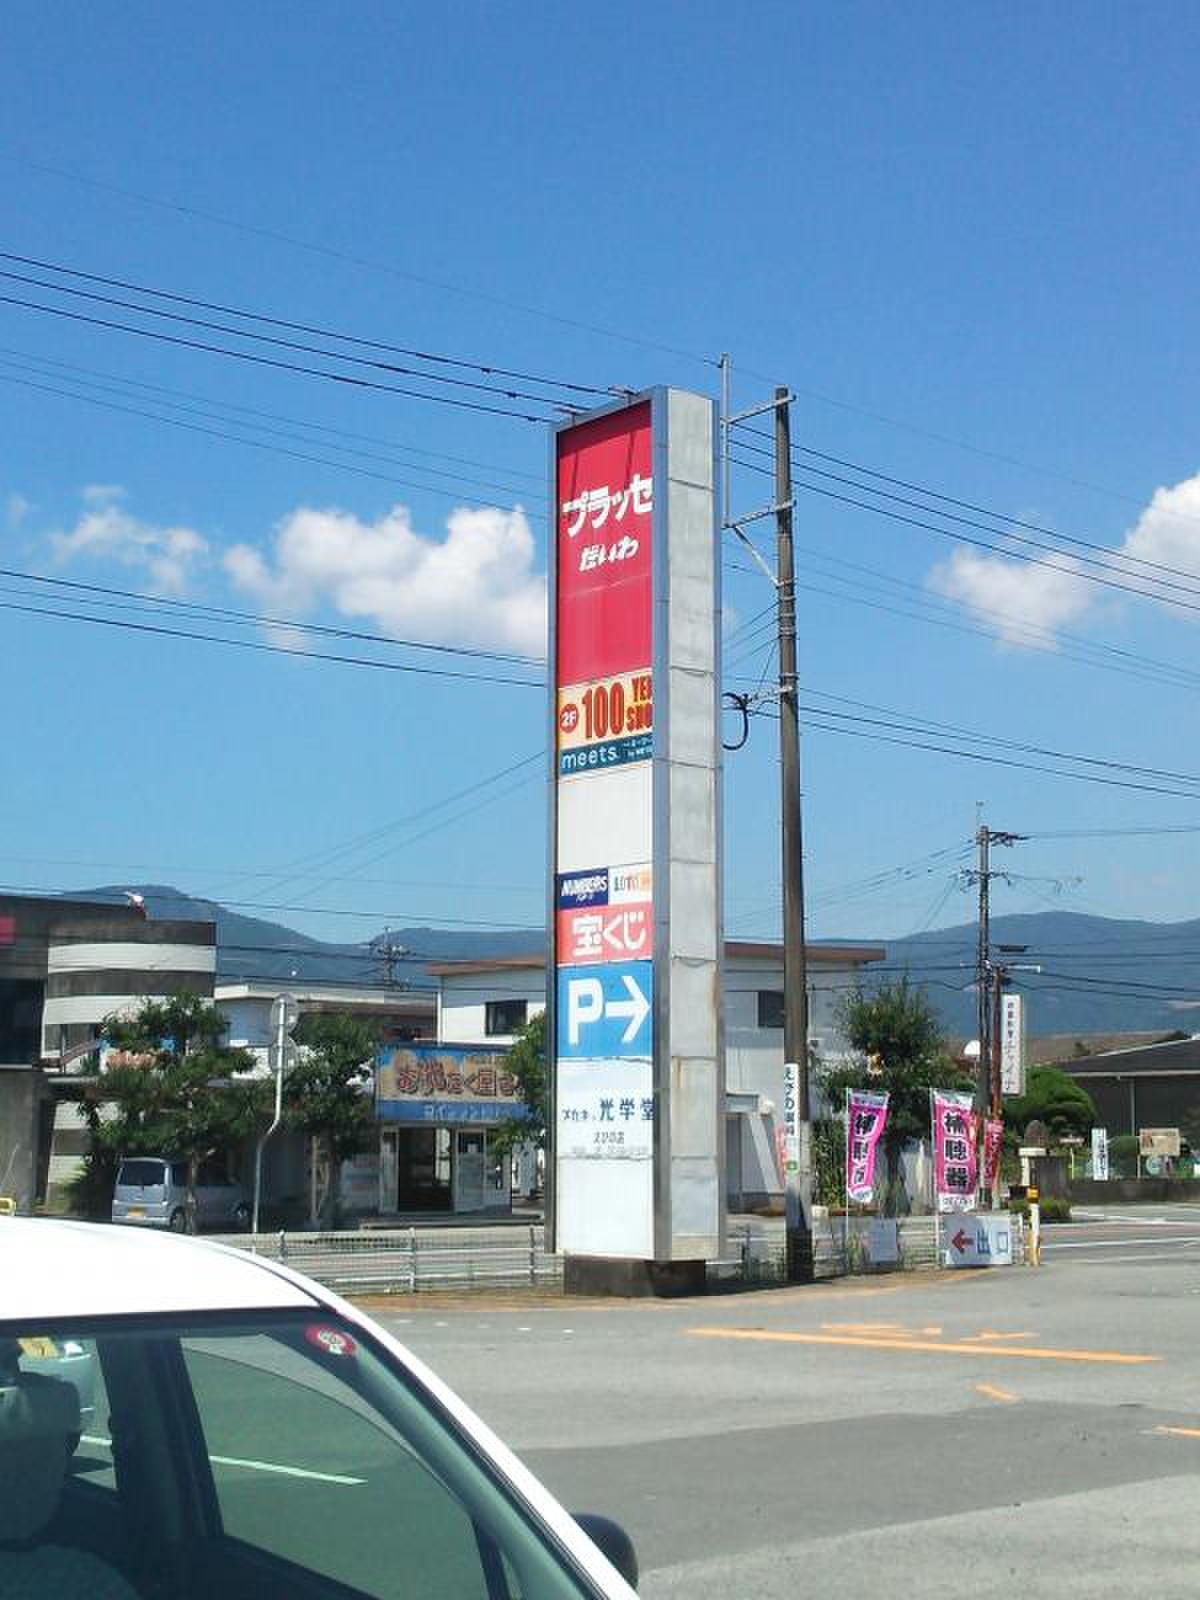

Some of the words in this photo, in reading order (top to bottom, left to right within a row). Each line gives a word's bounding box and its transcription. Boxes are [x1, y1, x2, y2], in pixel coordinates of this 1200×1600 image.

[563, 474, 652, 537] プラッセ
[579, 535, 638, 571] だいわ
[582, 682, 624, 738] 100
[573, 911, 646, 956] 宝くじ
[568, 978, 603, 1045] P
[944, 1112, 969, 1187] 補聴器
[976, 1227, 1009, 1255] 出口
